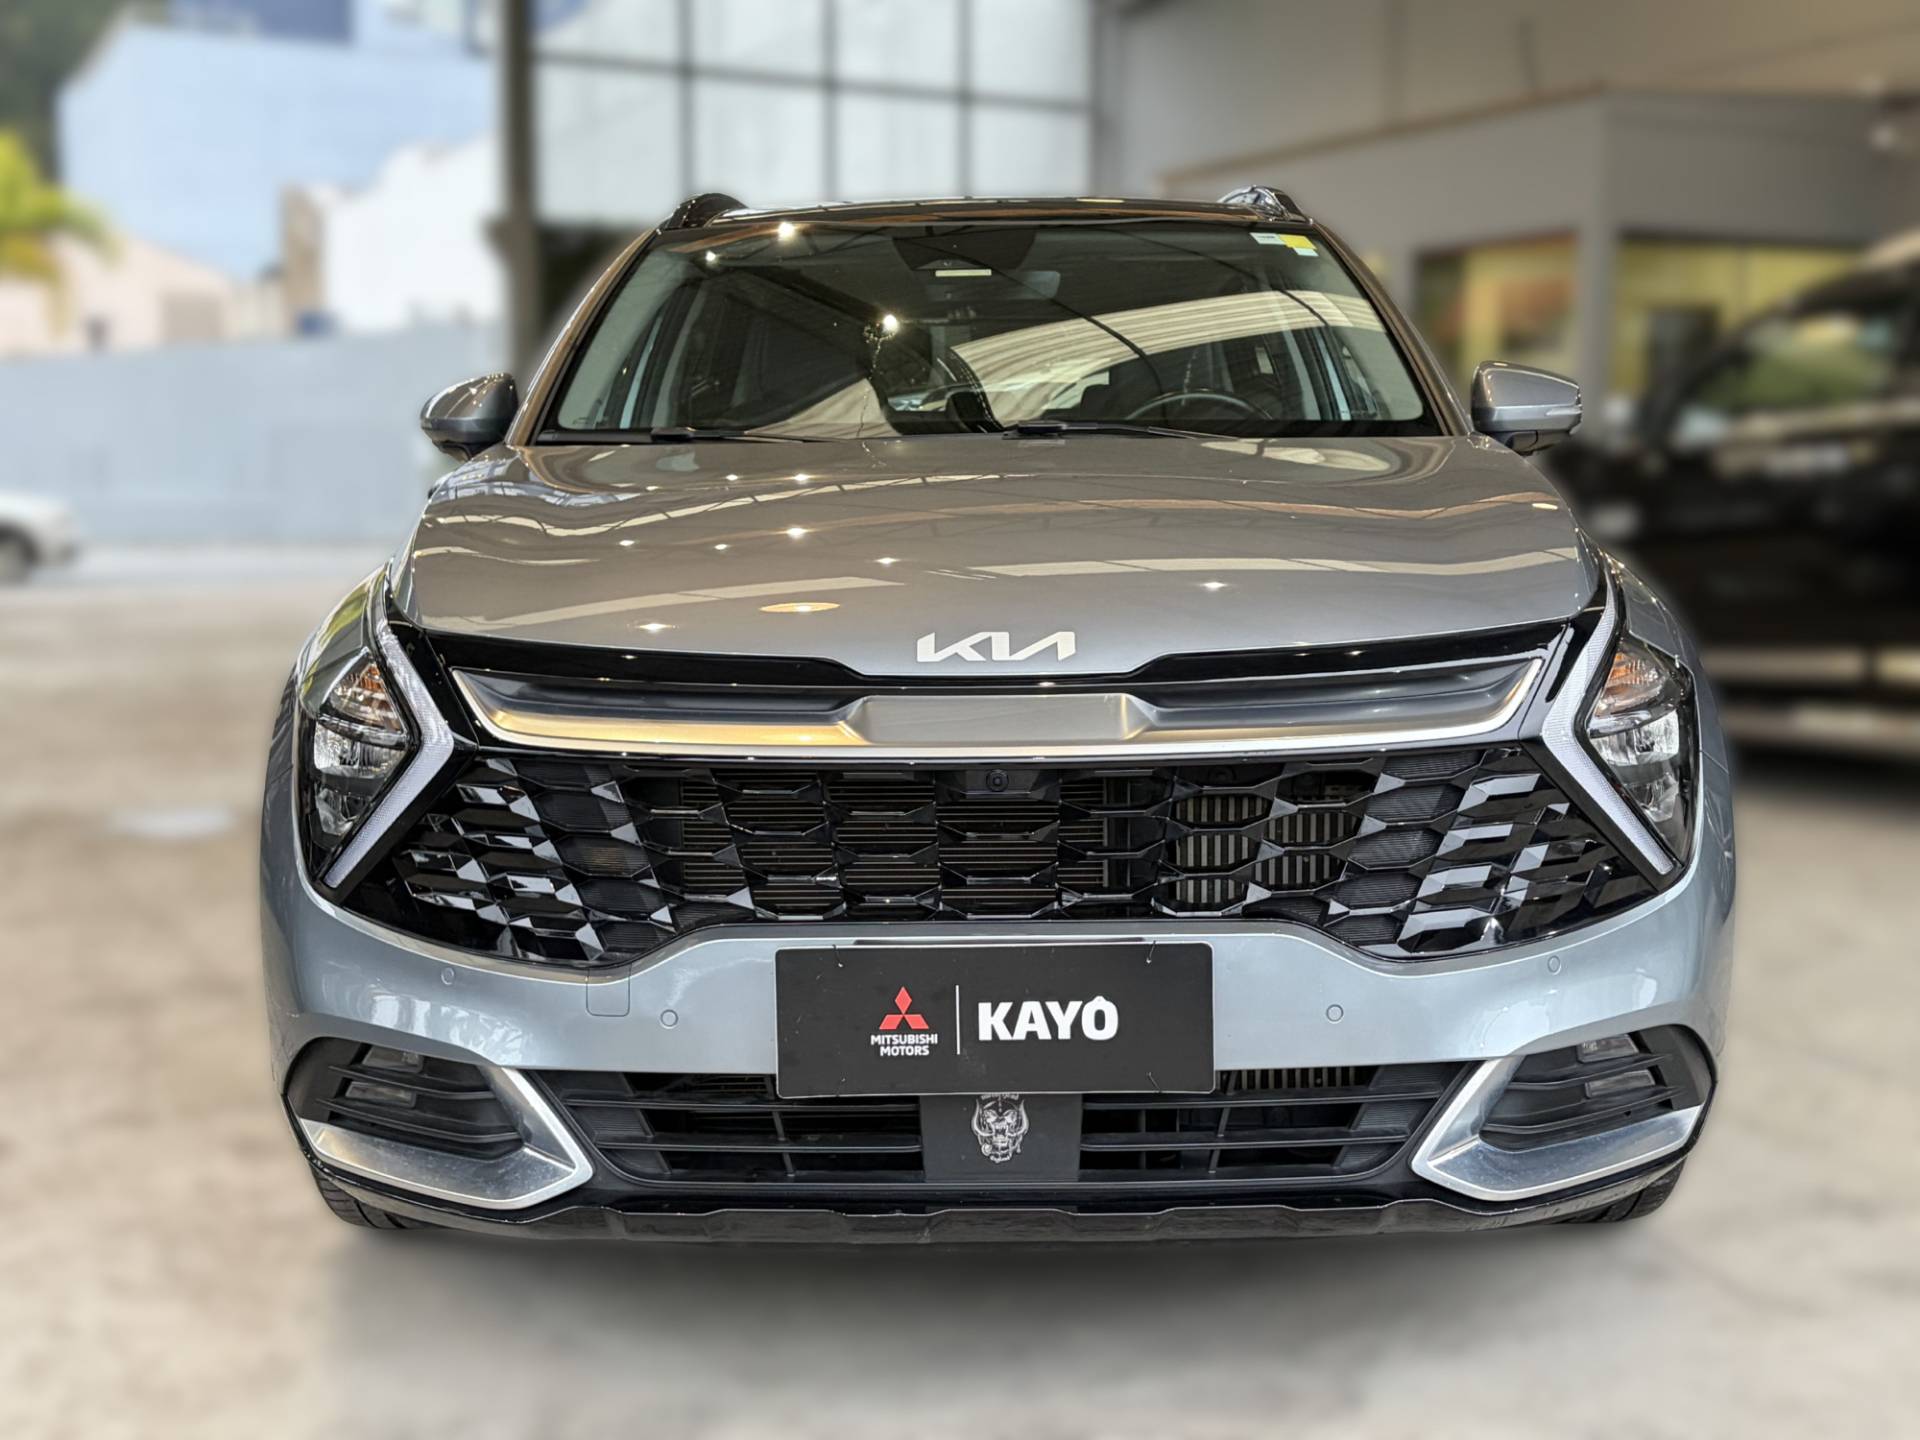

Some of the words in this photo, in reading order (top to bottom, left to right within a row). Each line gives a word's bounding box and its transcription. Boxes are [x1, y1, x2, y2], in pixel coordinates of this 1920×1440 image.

[917, 631, 1076, 662] KIA
[978, 995, 1119, 1041] KAYÔ
[870, 1033, 938, 1046] MITSUBISHI
[880, 1045, 930, 1057] MOTORS
